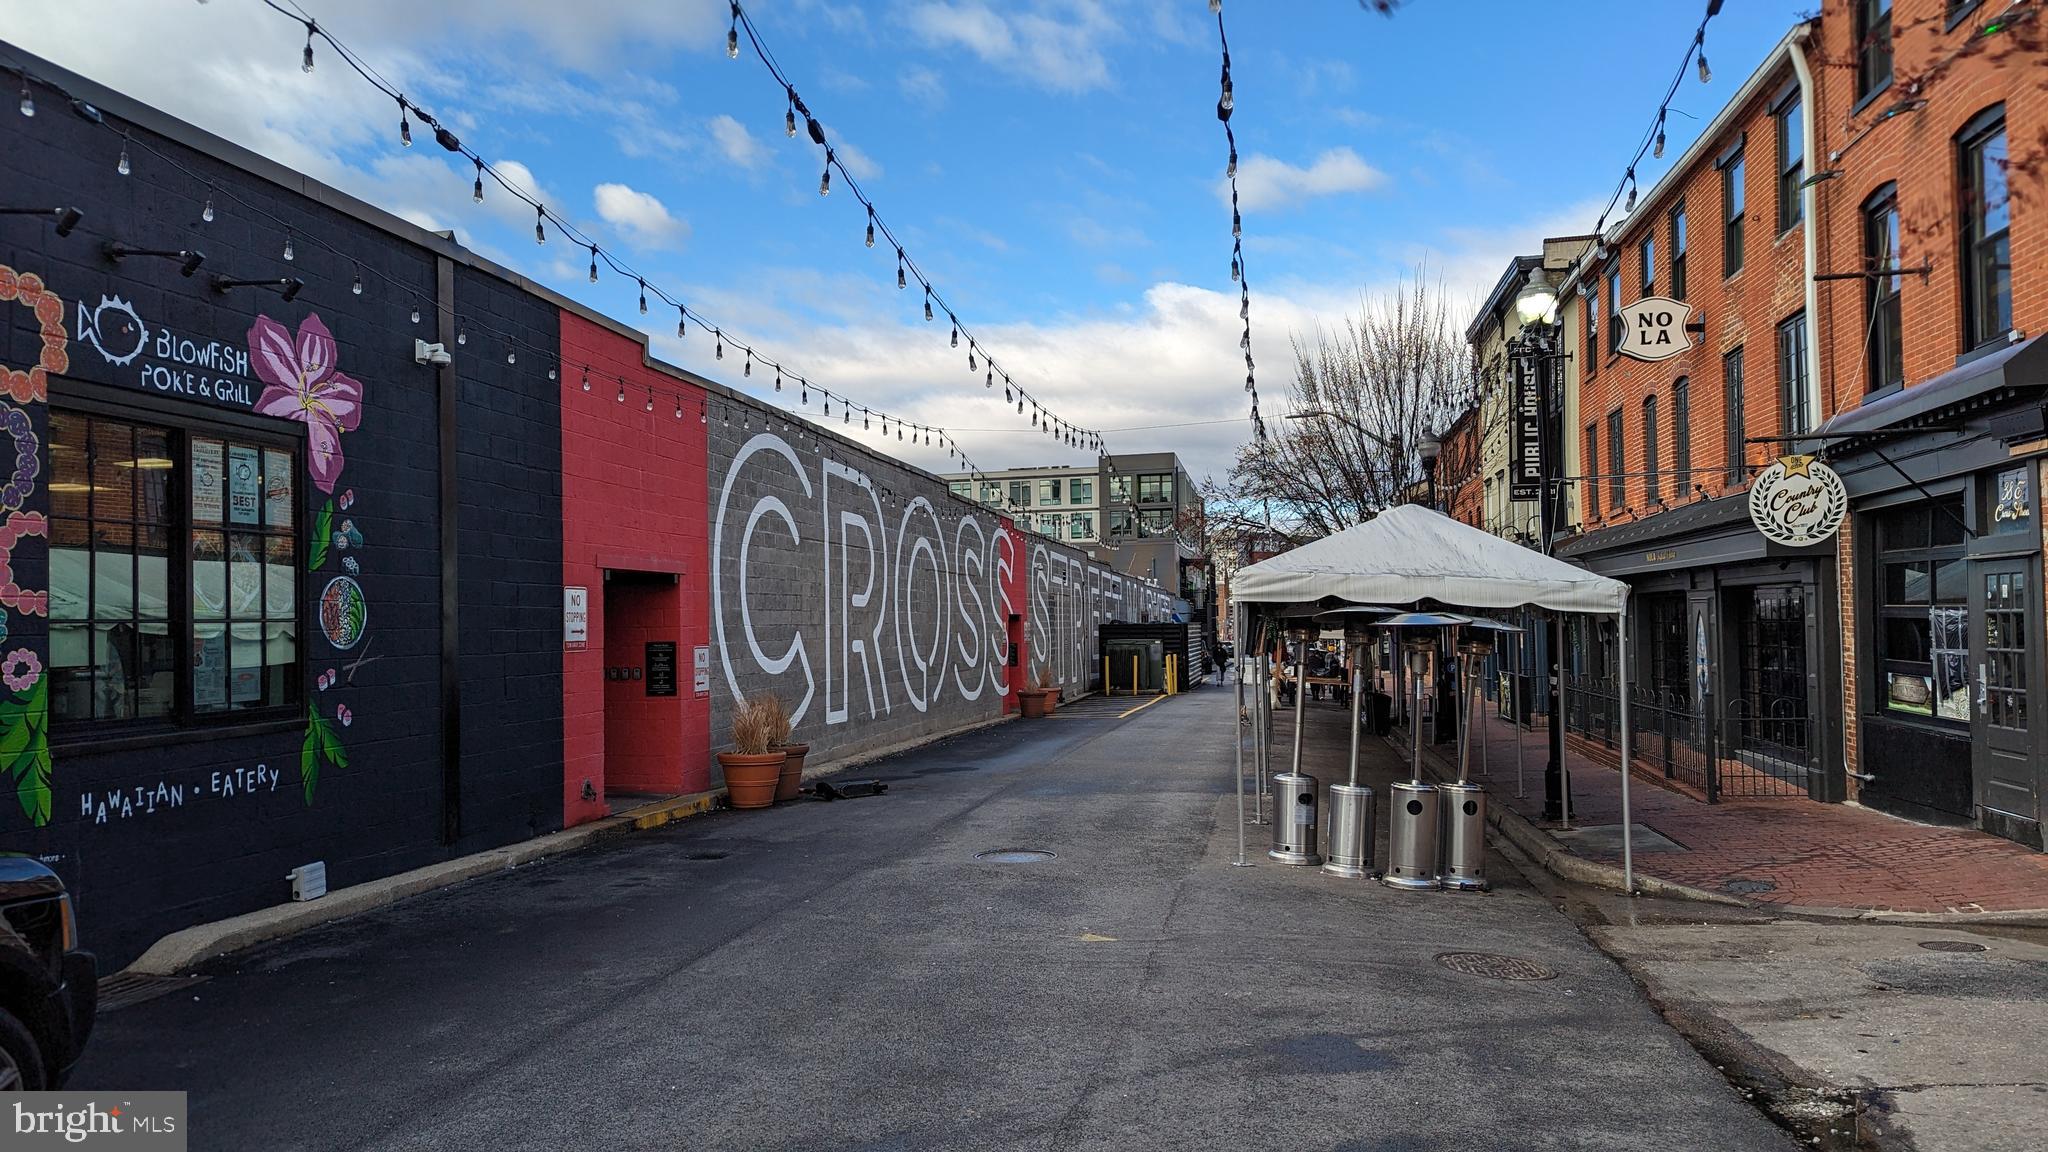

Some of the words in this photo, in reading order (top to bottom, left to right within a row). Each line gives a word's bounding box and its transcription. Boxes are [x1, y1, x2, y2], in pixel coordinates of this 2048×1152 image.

[1638, 311, 1673, 328] NO
[1640, 329, 1672, 345] LA
[157, 328, 248, 377] BLOWFISH
[199, 376, 211, 397] &
[214, 379, 252, 405] GRILL
[233, 495, 256, 507] BEST
[1513, 488, 1535, 496] EST.
[1770, 484, 1824, 512] Country
[1783, 501, 1818, 524] Club
[713, 433, 1014, 730] CROSS
[1031, 544, 1122, 686] STREET
[571, 594, 581, 607] NO
[566, 612, 586, 623] STOPPING
[81, 781, 184, 824] HAWAIIAN
[211, 764, 280, 798] EATERY
